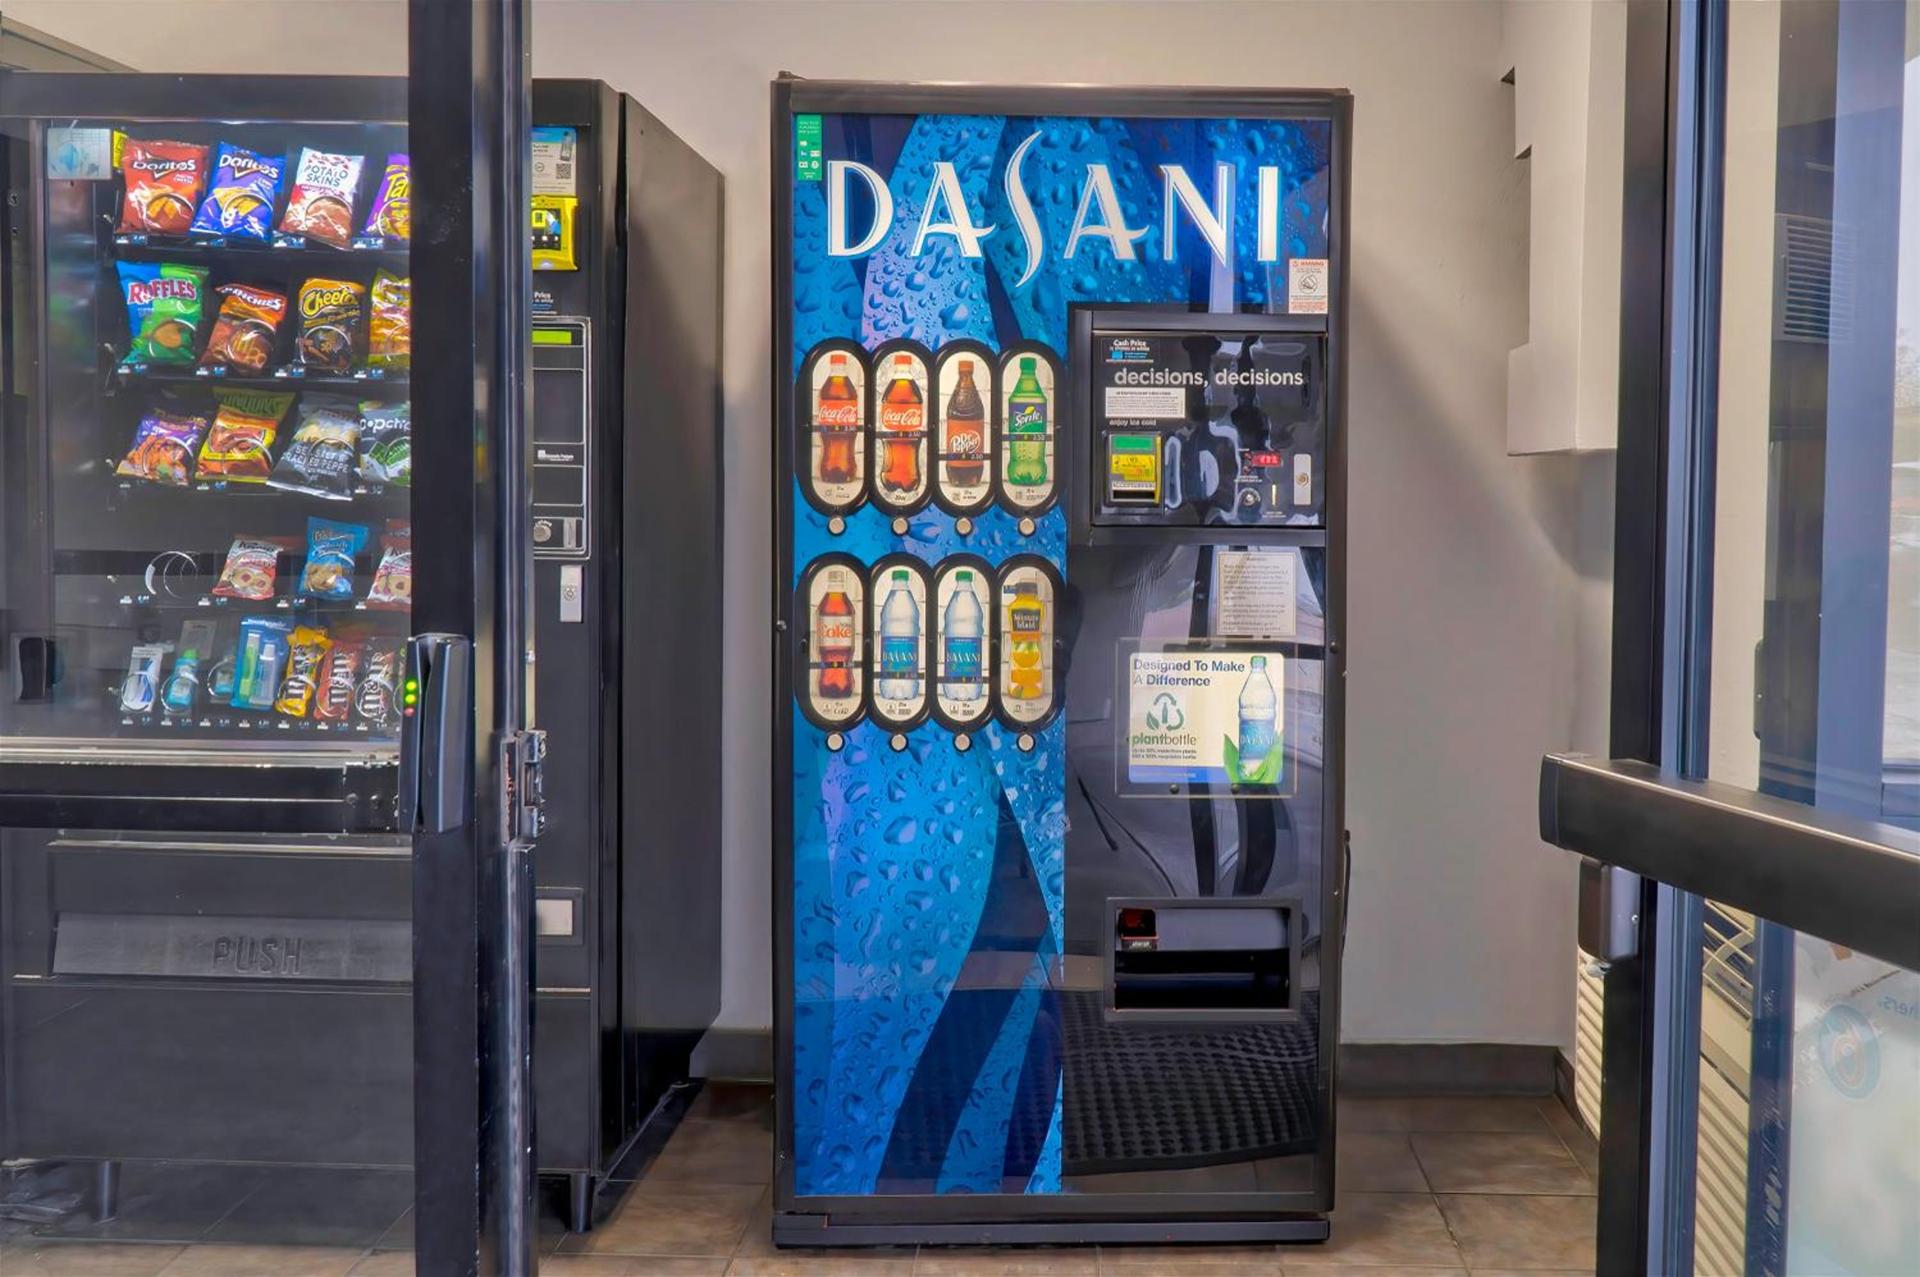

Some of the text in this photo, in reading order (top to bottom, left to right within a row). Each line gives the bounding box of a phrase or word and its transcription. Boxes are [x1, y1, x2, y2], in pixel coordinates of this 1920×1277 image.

[132, 159, 197, 172] Doritos
[219, 154, 280, 179] Doritos
[304, 164, 349, 180] POTATO
[306, 173, 341, 188] SKINS
[827, 130, 1280, 288] DASANI
[127, 278, 197, 305] RUFFLES
[1113, 339, 1147, 347] Cash Price
[1114, 367, 1304, 387] decisions, decisions
[883, 409, 921, 426] Coca-Cola
[1014, 410, 1043, 428] Sprite
[1133, 658, 1245, 673] Designed To Make
[1133, 674, 1211, 687] A Difference
[1131, 732, 1198, 748] plantbottle
[212, 935, 302, 975] PUSH
